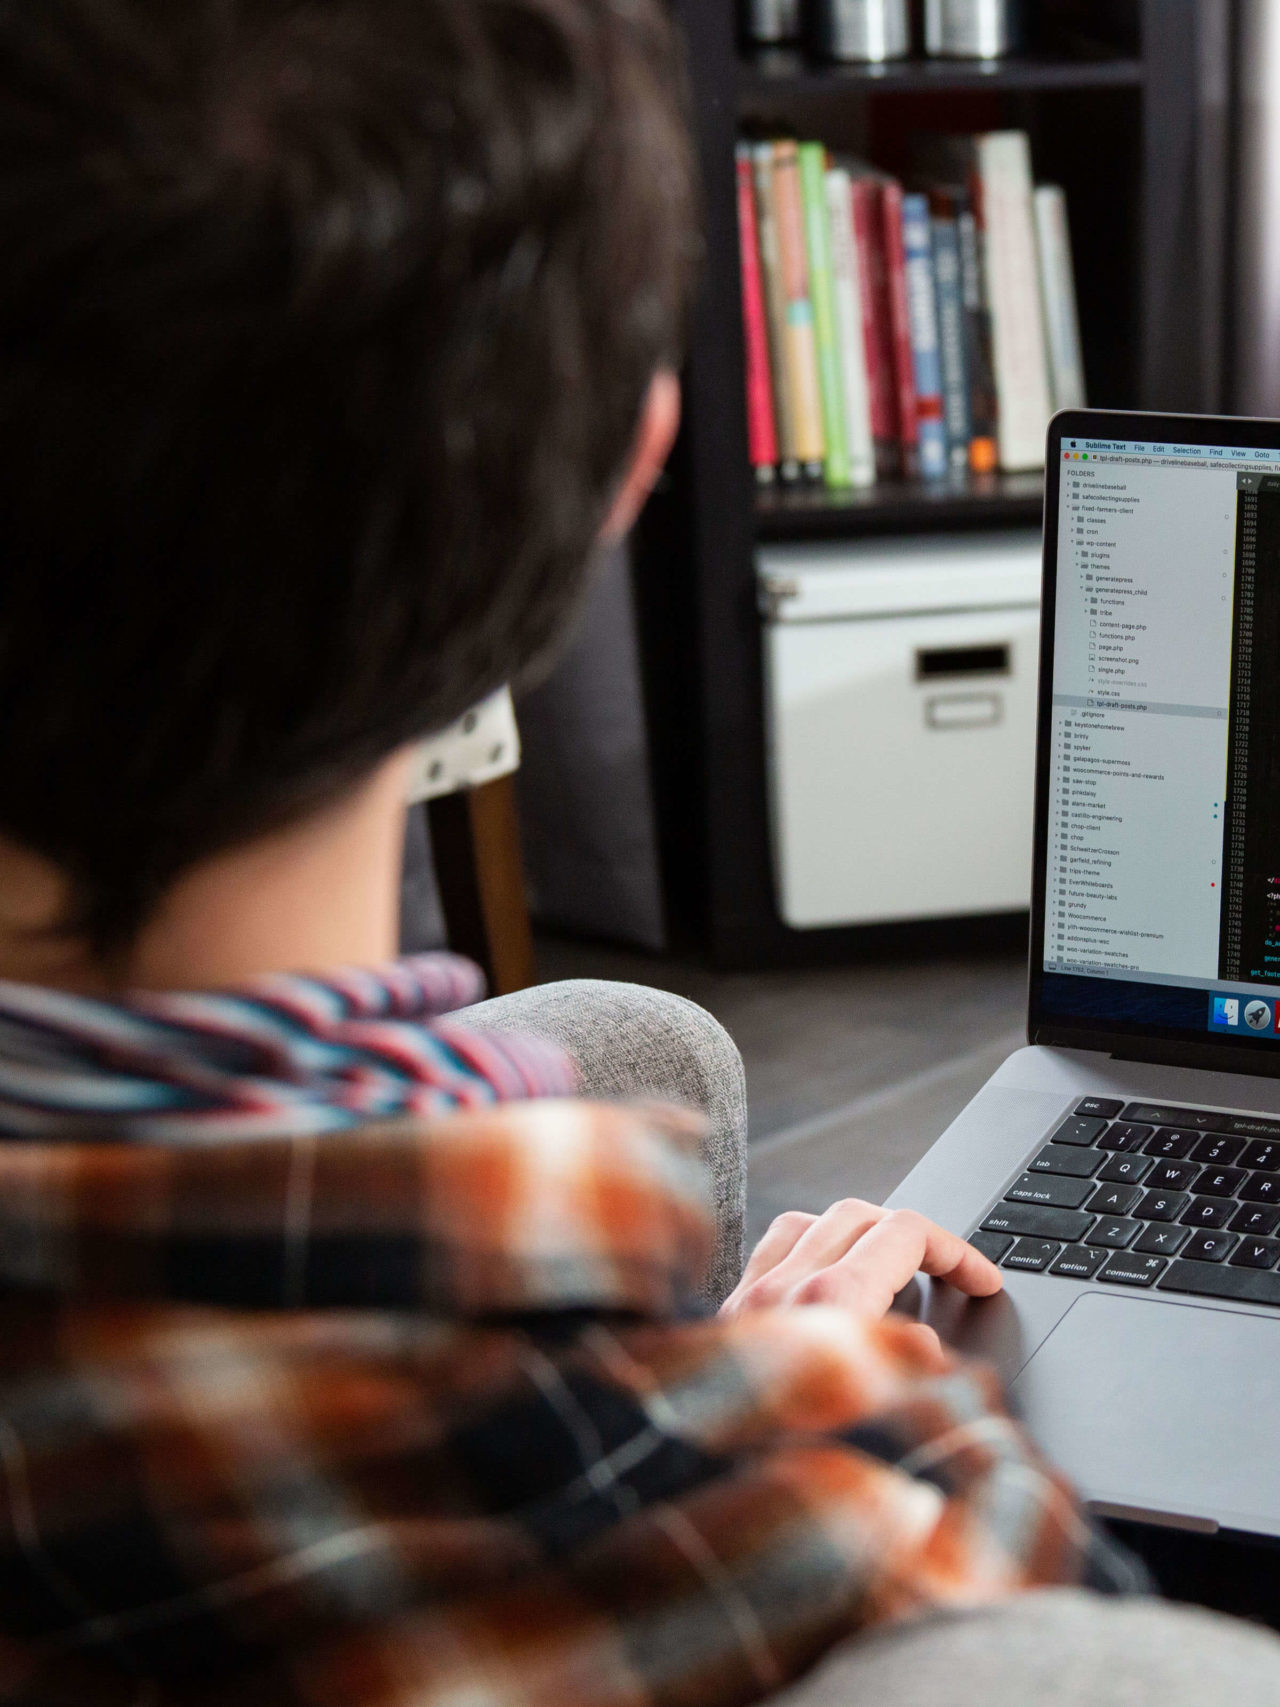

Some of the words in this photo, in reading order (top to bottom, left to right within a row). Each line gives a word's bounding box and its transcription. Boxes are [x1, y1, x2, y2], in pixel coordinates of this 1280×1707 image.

[1172, 446, 1200, 454] Selection
[1100, 455, 1152, 464] tpl-draft-posts.php
[1086, 540, 1116, 548] wp-content
[1090, 551, 1109, 559] plugins
[1099, 621, 1146, 631] content-page.php
[1097, 689, 1119, 697] style.css
[1068, 901, 1086, 909] grundy
[1120, 1164, 1130, 1172] Q
[1166, 1170, 1179, 1178] W
[1261, 1183, 1271, 1191] R
[1155, 1201, 1165, 1209] S
[1108, 1228, 1119, 1236] Z
[1156, 1234, 1167, 1242] X
[1204, 1241, 1215, 1249] C
[1255, 1247, 1264, 1255] V
[1106, 1270, 1148, 1280] command
